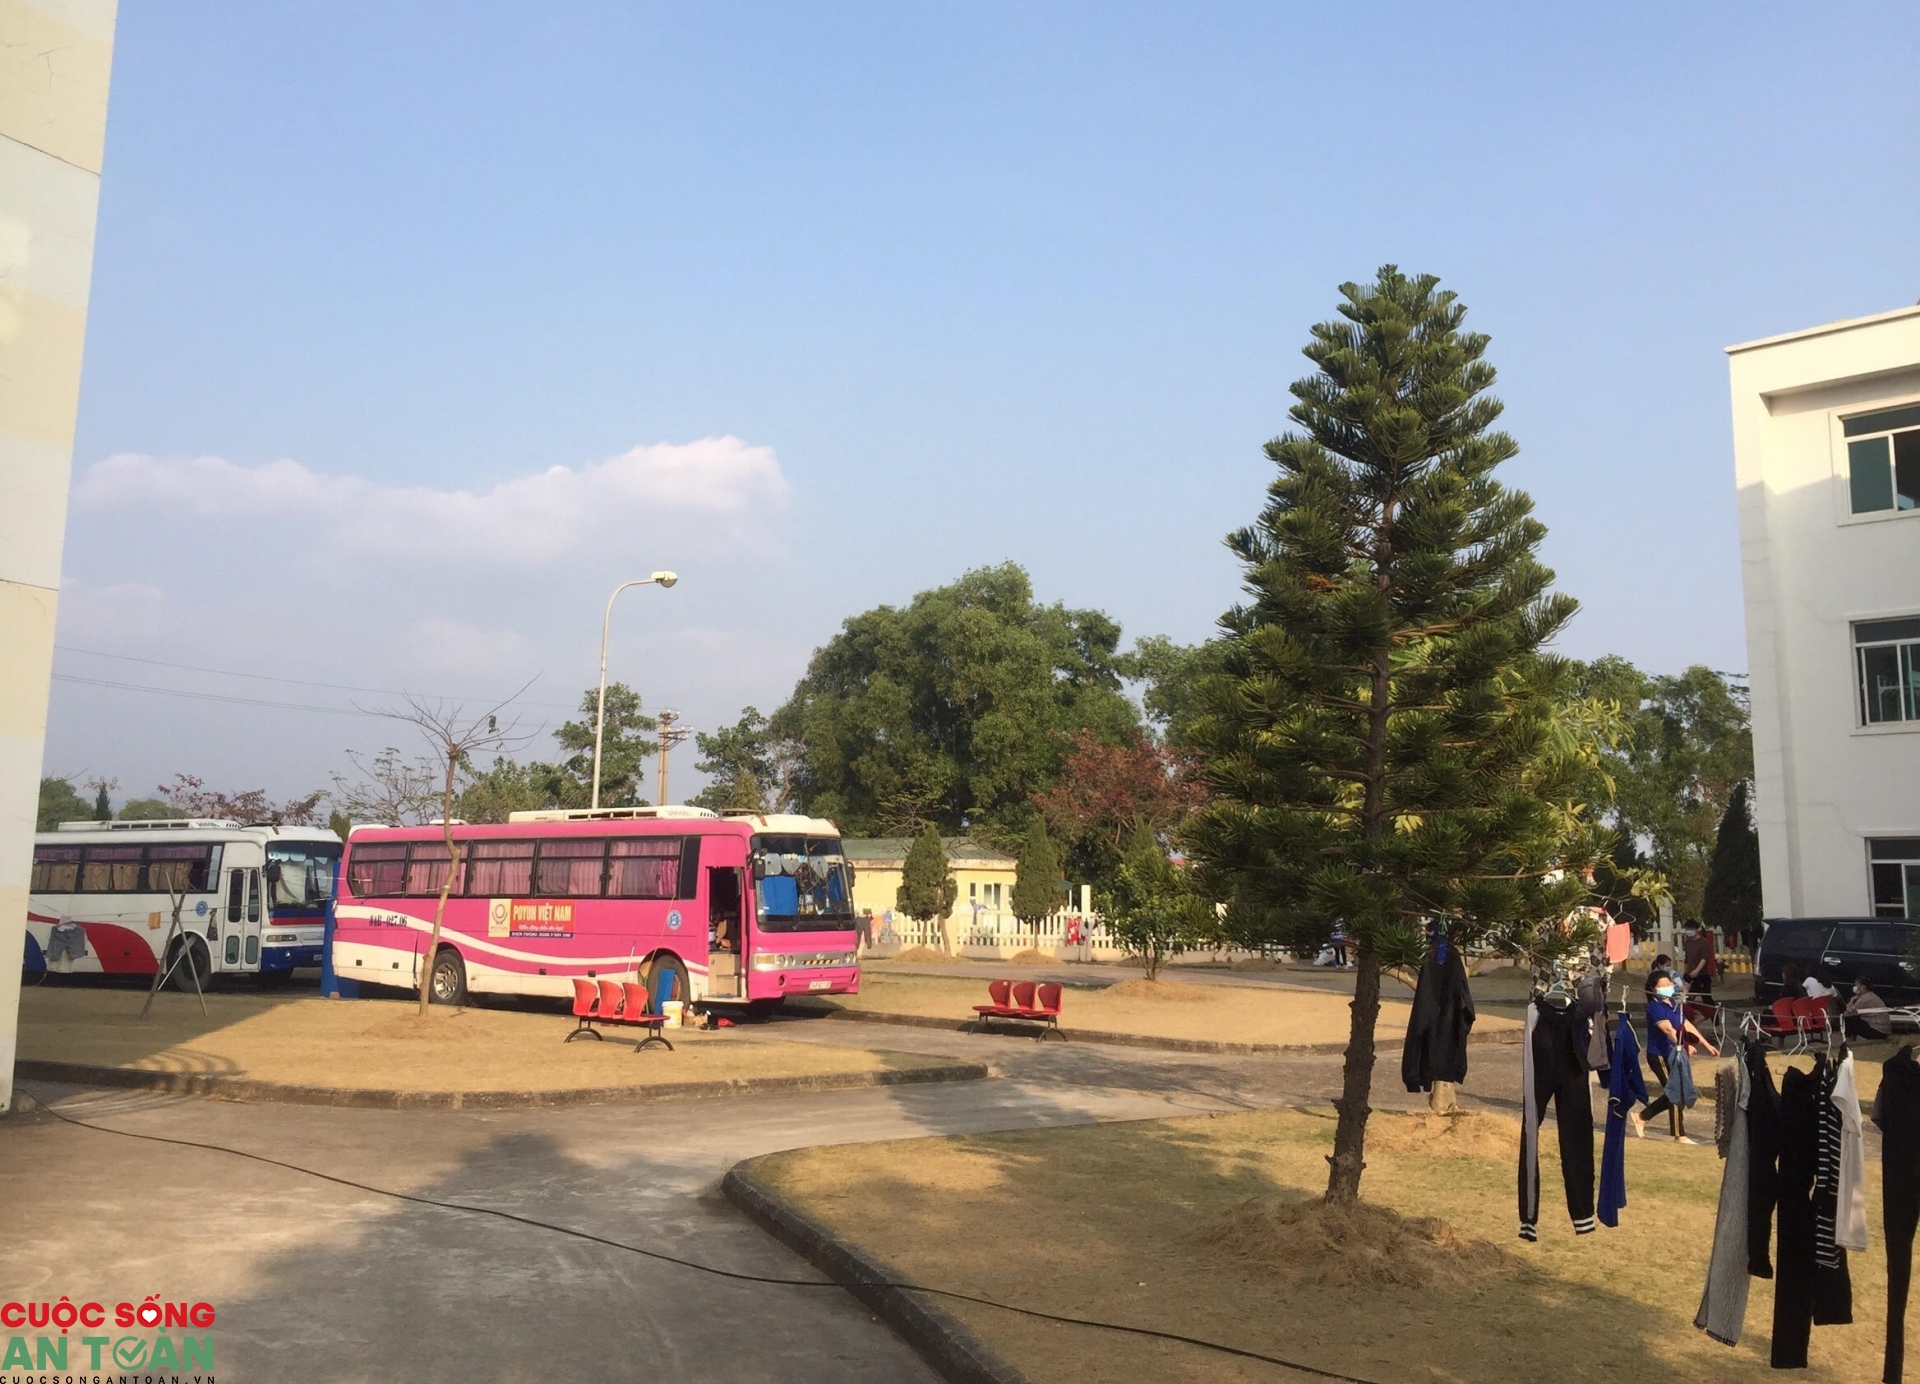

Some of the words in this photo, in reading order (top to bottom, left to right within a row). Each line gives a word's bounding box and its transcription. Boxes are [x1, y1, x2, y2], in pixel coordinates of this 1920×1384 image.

[513, 905, 537, 922] POYUN
[538, 902, 554, 925] VIỆT
[554, 905, 572, 922] NAM
